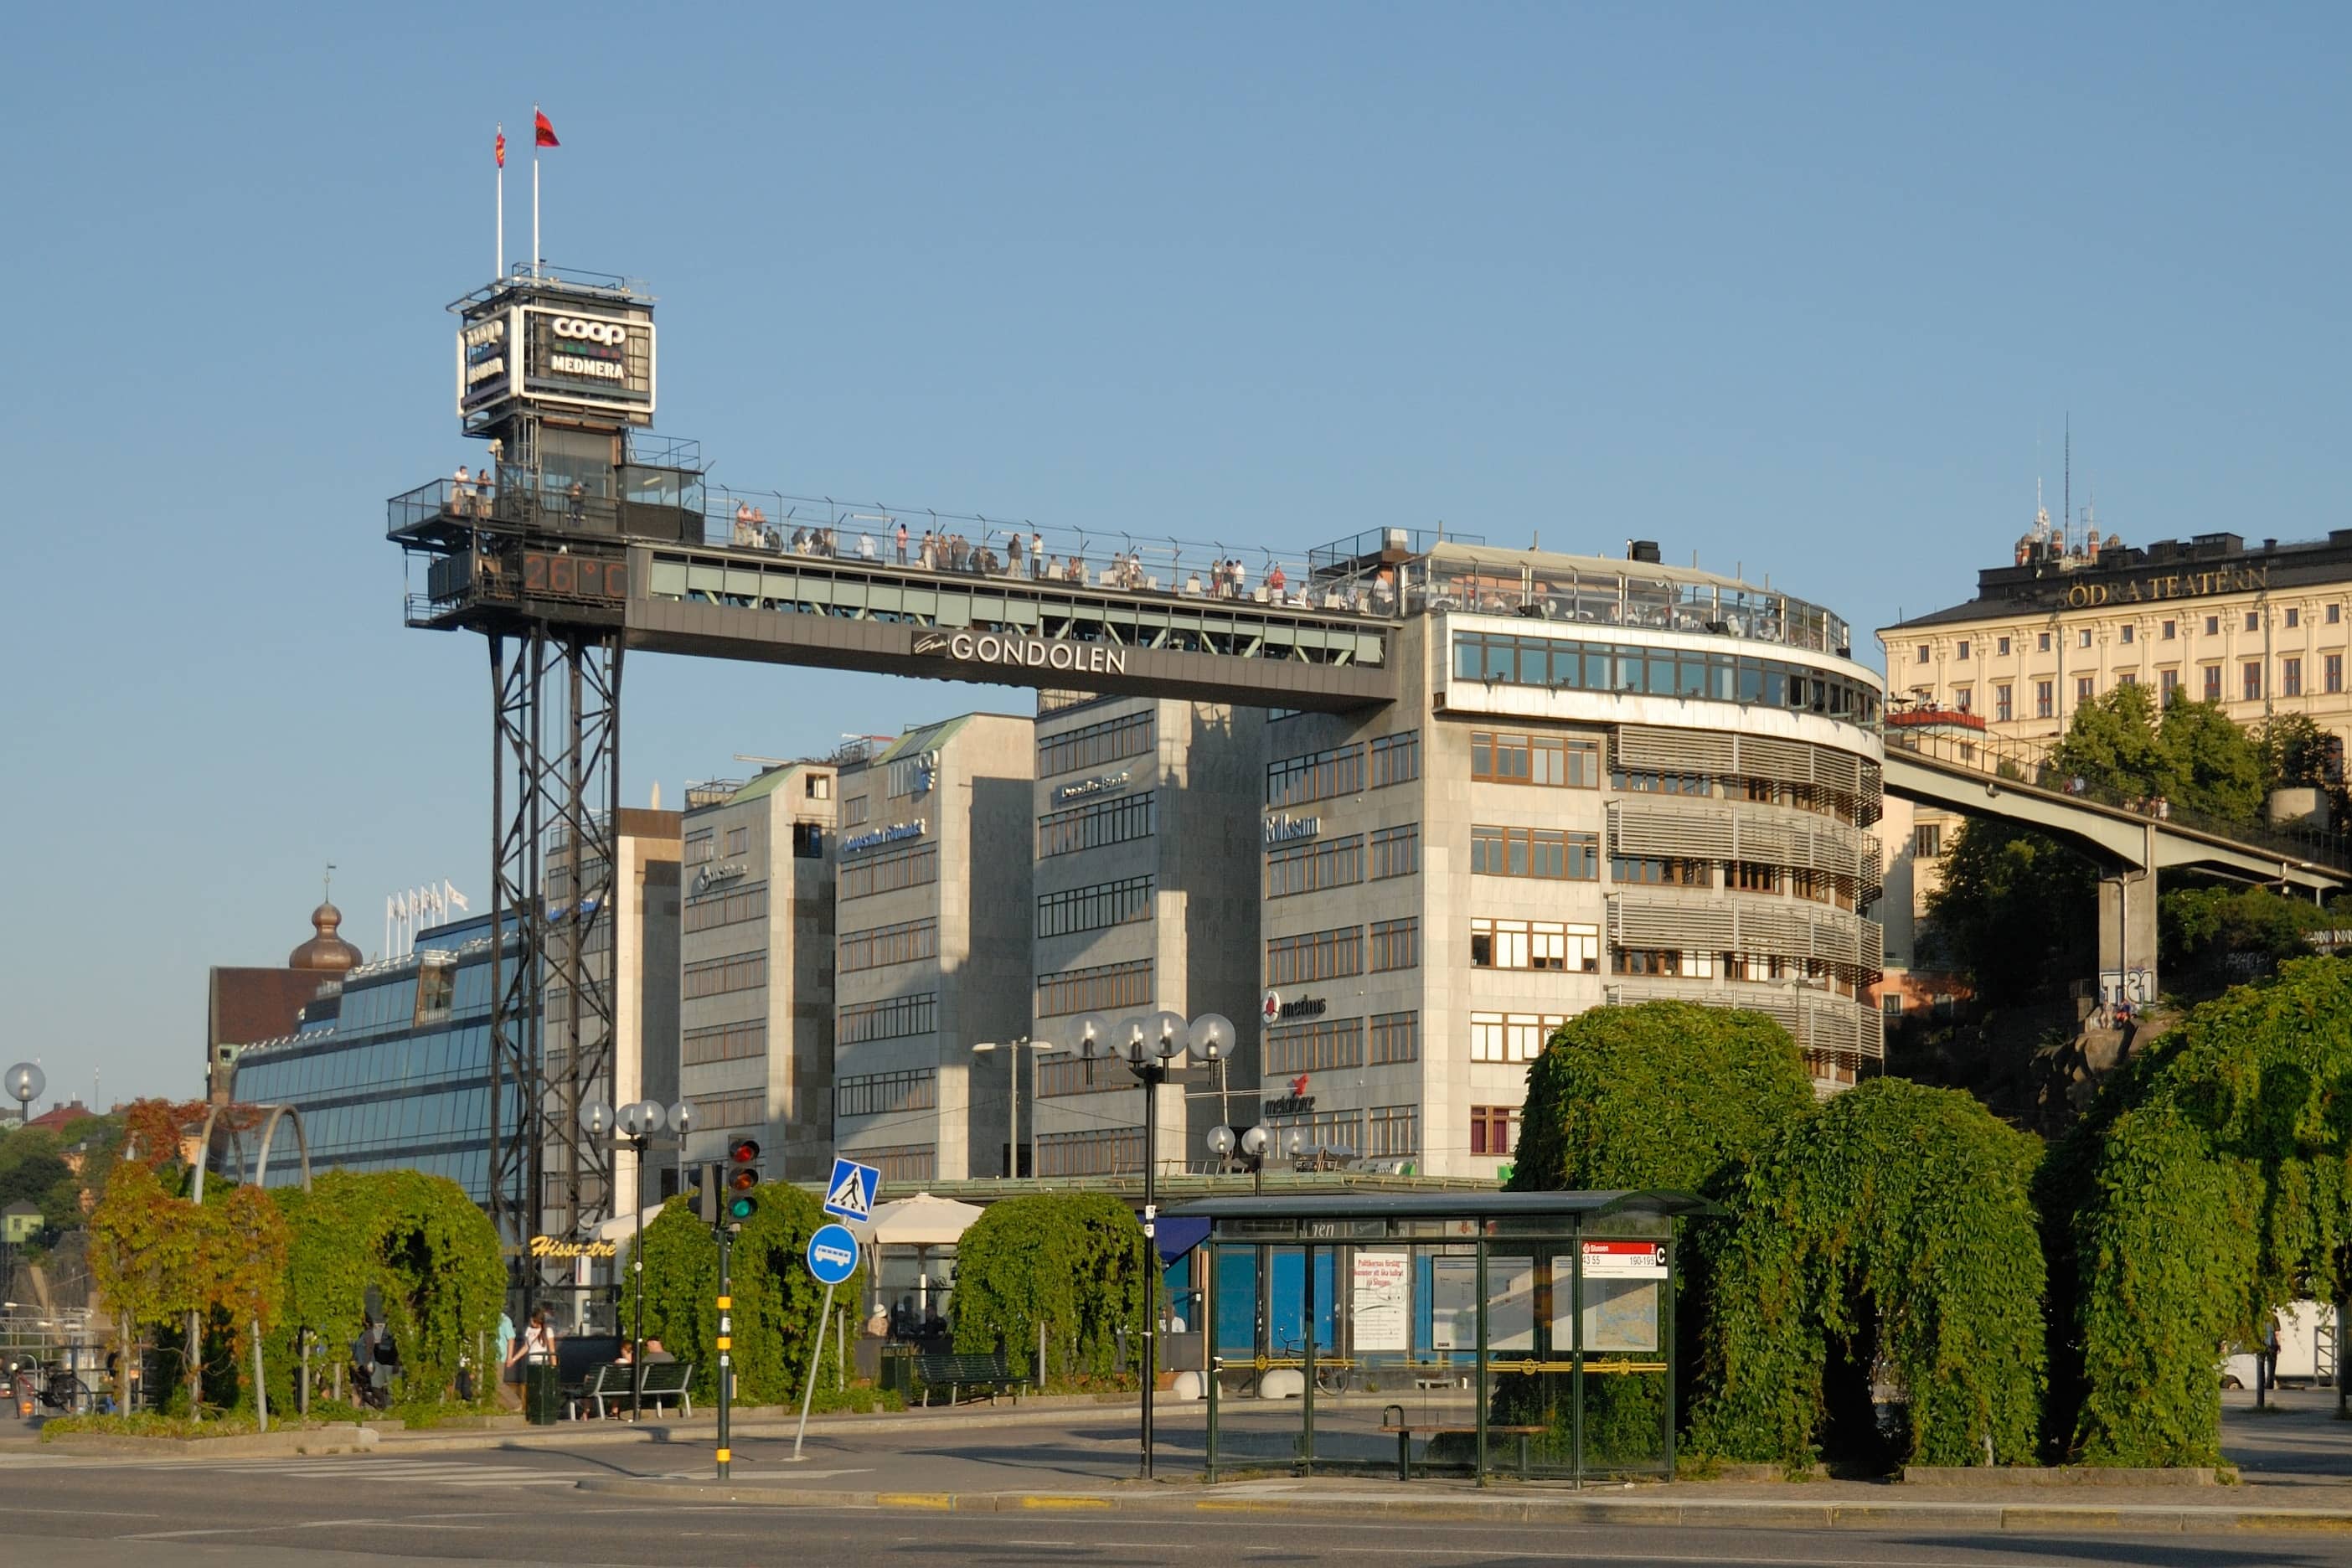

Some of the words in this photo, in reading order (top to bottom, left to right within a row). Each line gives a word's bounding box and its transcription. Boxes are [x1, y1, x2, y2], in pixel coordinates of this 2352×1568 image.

[552, 317, 627, 346] coop
[551, 354, 624, 379] MEDMERA
[2057, 577, 2143, 609] SÖDRA
[2148, 566, 2268, 600] TEATERN
[952, 634, 1126, 673] GONDOLEN
[1656, 1246, 1666, 1264] C
